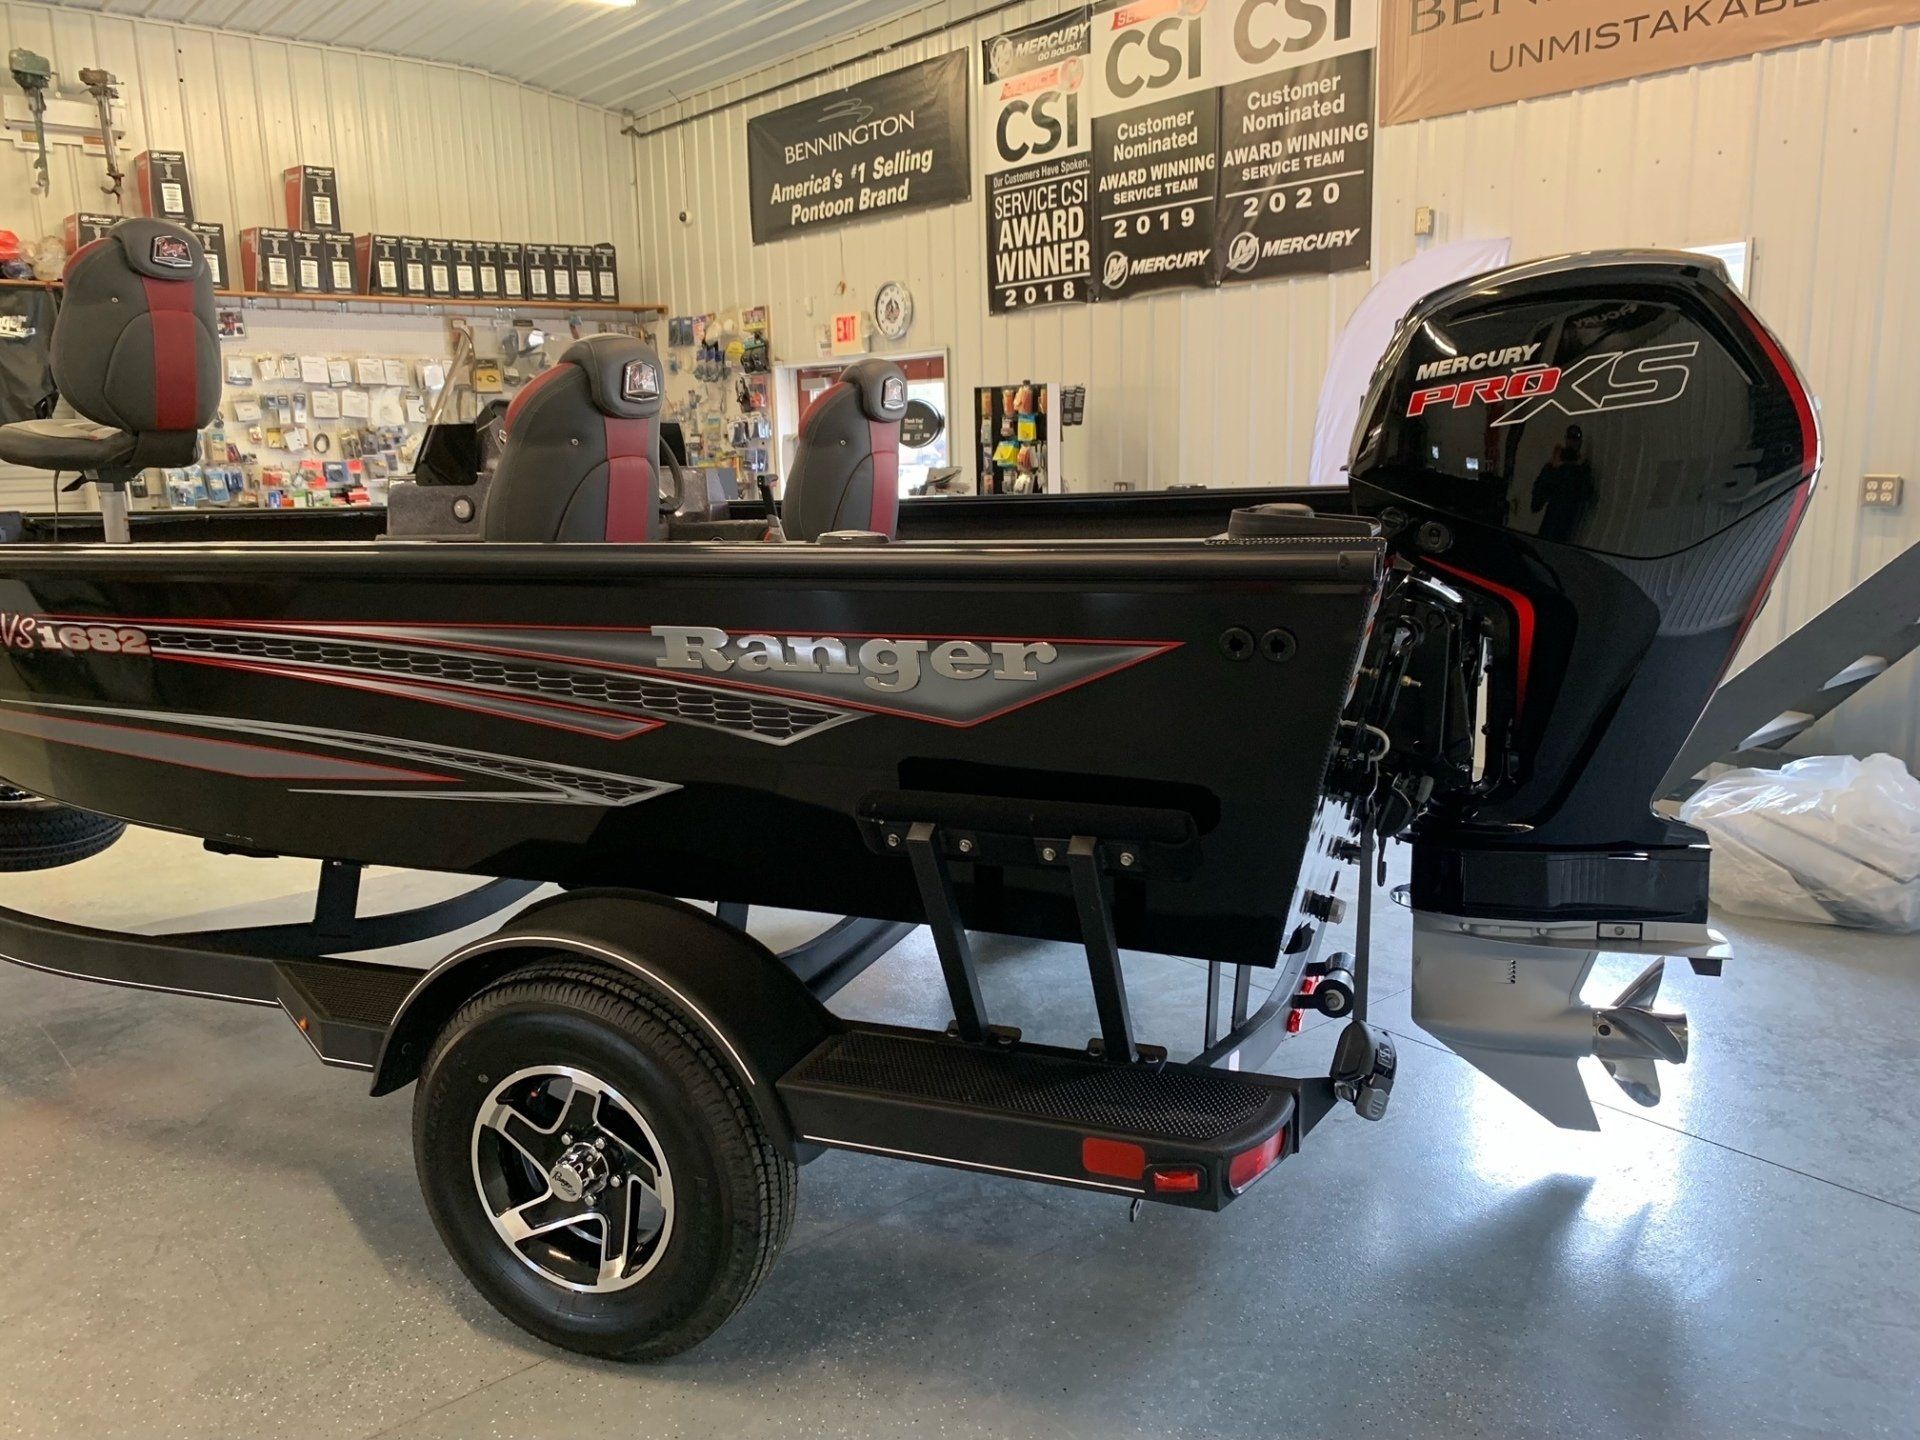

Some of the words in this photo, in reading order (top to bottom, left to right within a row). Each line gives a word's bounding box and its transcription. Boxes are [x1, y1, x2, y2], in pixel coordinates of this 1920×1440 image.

[1016, 22, 1091, 57] MERCURY
[1233, 0, 1351, 65] CSI
[1105, 16, 1201, 99] CSI
[1247, 75, 1341, 111] Customer
[996, 91, 1078, 162] CSI
[1117, 110, 1194, 141] Customer
[1242, 93, 1345, 134] Nominated
[785, 110, 915, 165] BENNINGTON
[1114, 126, 1198, 162] Nominated
[1223, 140, 1282, 168] AWARD
[1287, 122, 1369, 154] WINNING
[771, 169, 843, 204] America's
[851, 162, 866, 183] #1
[873, 149, 933, 180] Selling
[993, 174, 1003, 188] Our
[1005, 169, 1040, 184] Customers
[1042, 165, 1059, 176] Have
[1099, 168, 1147, 192] AWARD
[1150, 153, 1215, 181] WINNING
[1242, 158, 1300, 181] SERVICE
[1304, 149, 1345, 169] TEAM
[791, 196, 854, 225] Pontoon
[859, 179, 909, 211] Brand
[995, 184, 1057, 220] SERVICE
[1061, 178, 1088, 206] CSI
[1113, 185, 1162, 205] SERVICE
[1165, 177, 1198, 195] TEAM
[999, 206, 1085, 251] AWARD
[1262, 227, 1360, 258] MERCURY
[996, 239, 1090, 283] WINNER
[1130, 249, 1211, 276] MERCURY
[836, 316, 855, 342] EXIT
[1415, 342, 1541, 381] MERCURY
[650, 625, 1058, 693] Ranger
